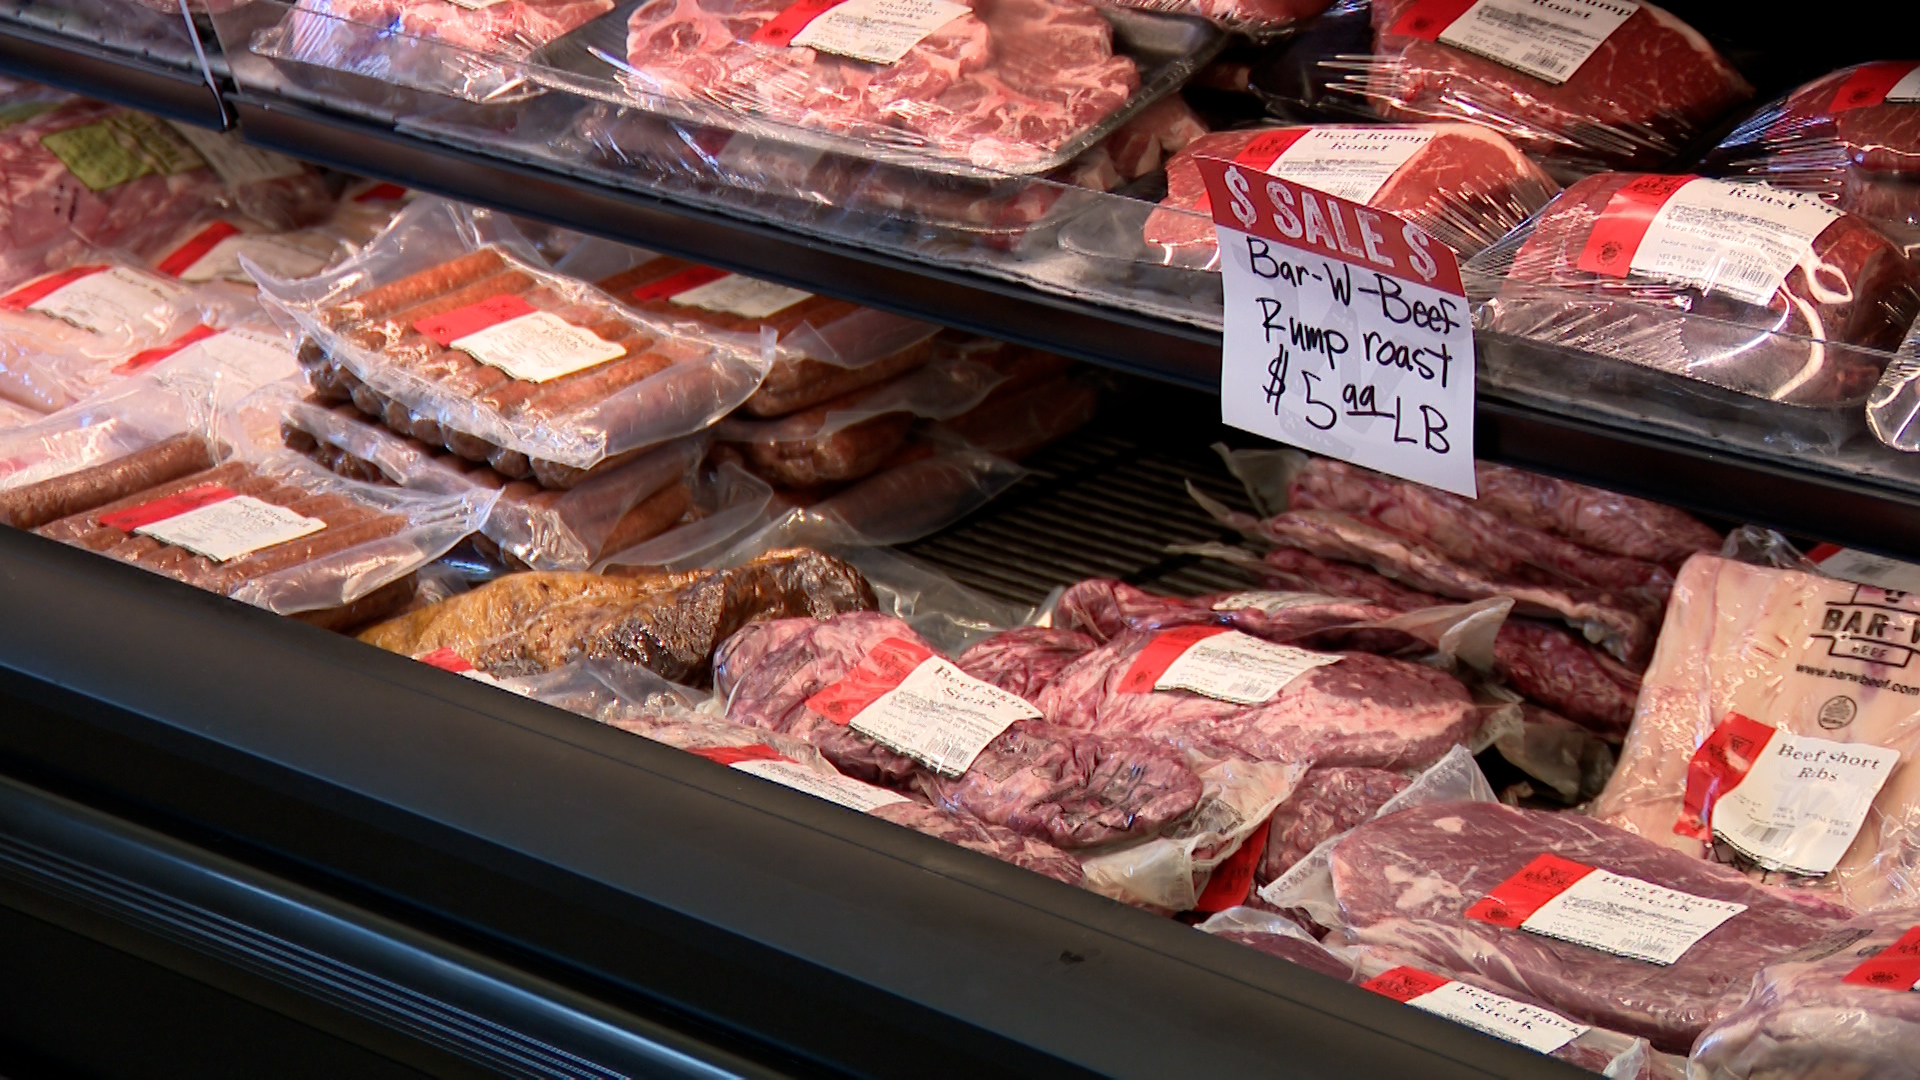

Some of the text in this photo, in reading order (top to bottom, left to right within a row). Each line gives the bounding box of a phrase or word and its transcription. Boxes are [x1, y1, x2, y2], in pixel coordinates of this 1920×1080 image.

[1330, 142, 1389, 152] Roast
[1728, 187, 1795, 209] Roast
[1266, 180, 1396, 268] SALE
[1255, 297, 1453, 388] Rump roast
[1796, 664, 1919, 696] www.barwbeef.com
[1777, 743, 1826, 762] Beef
[1797, 766, 1839, 782] Ribs
[1456, 984, 1511, 1008] Beef
[1471, 1002, 1533, 1031] Steak
